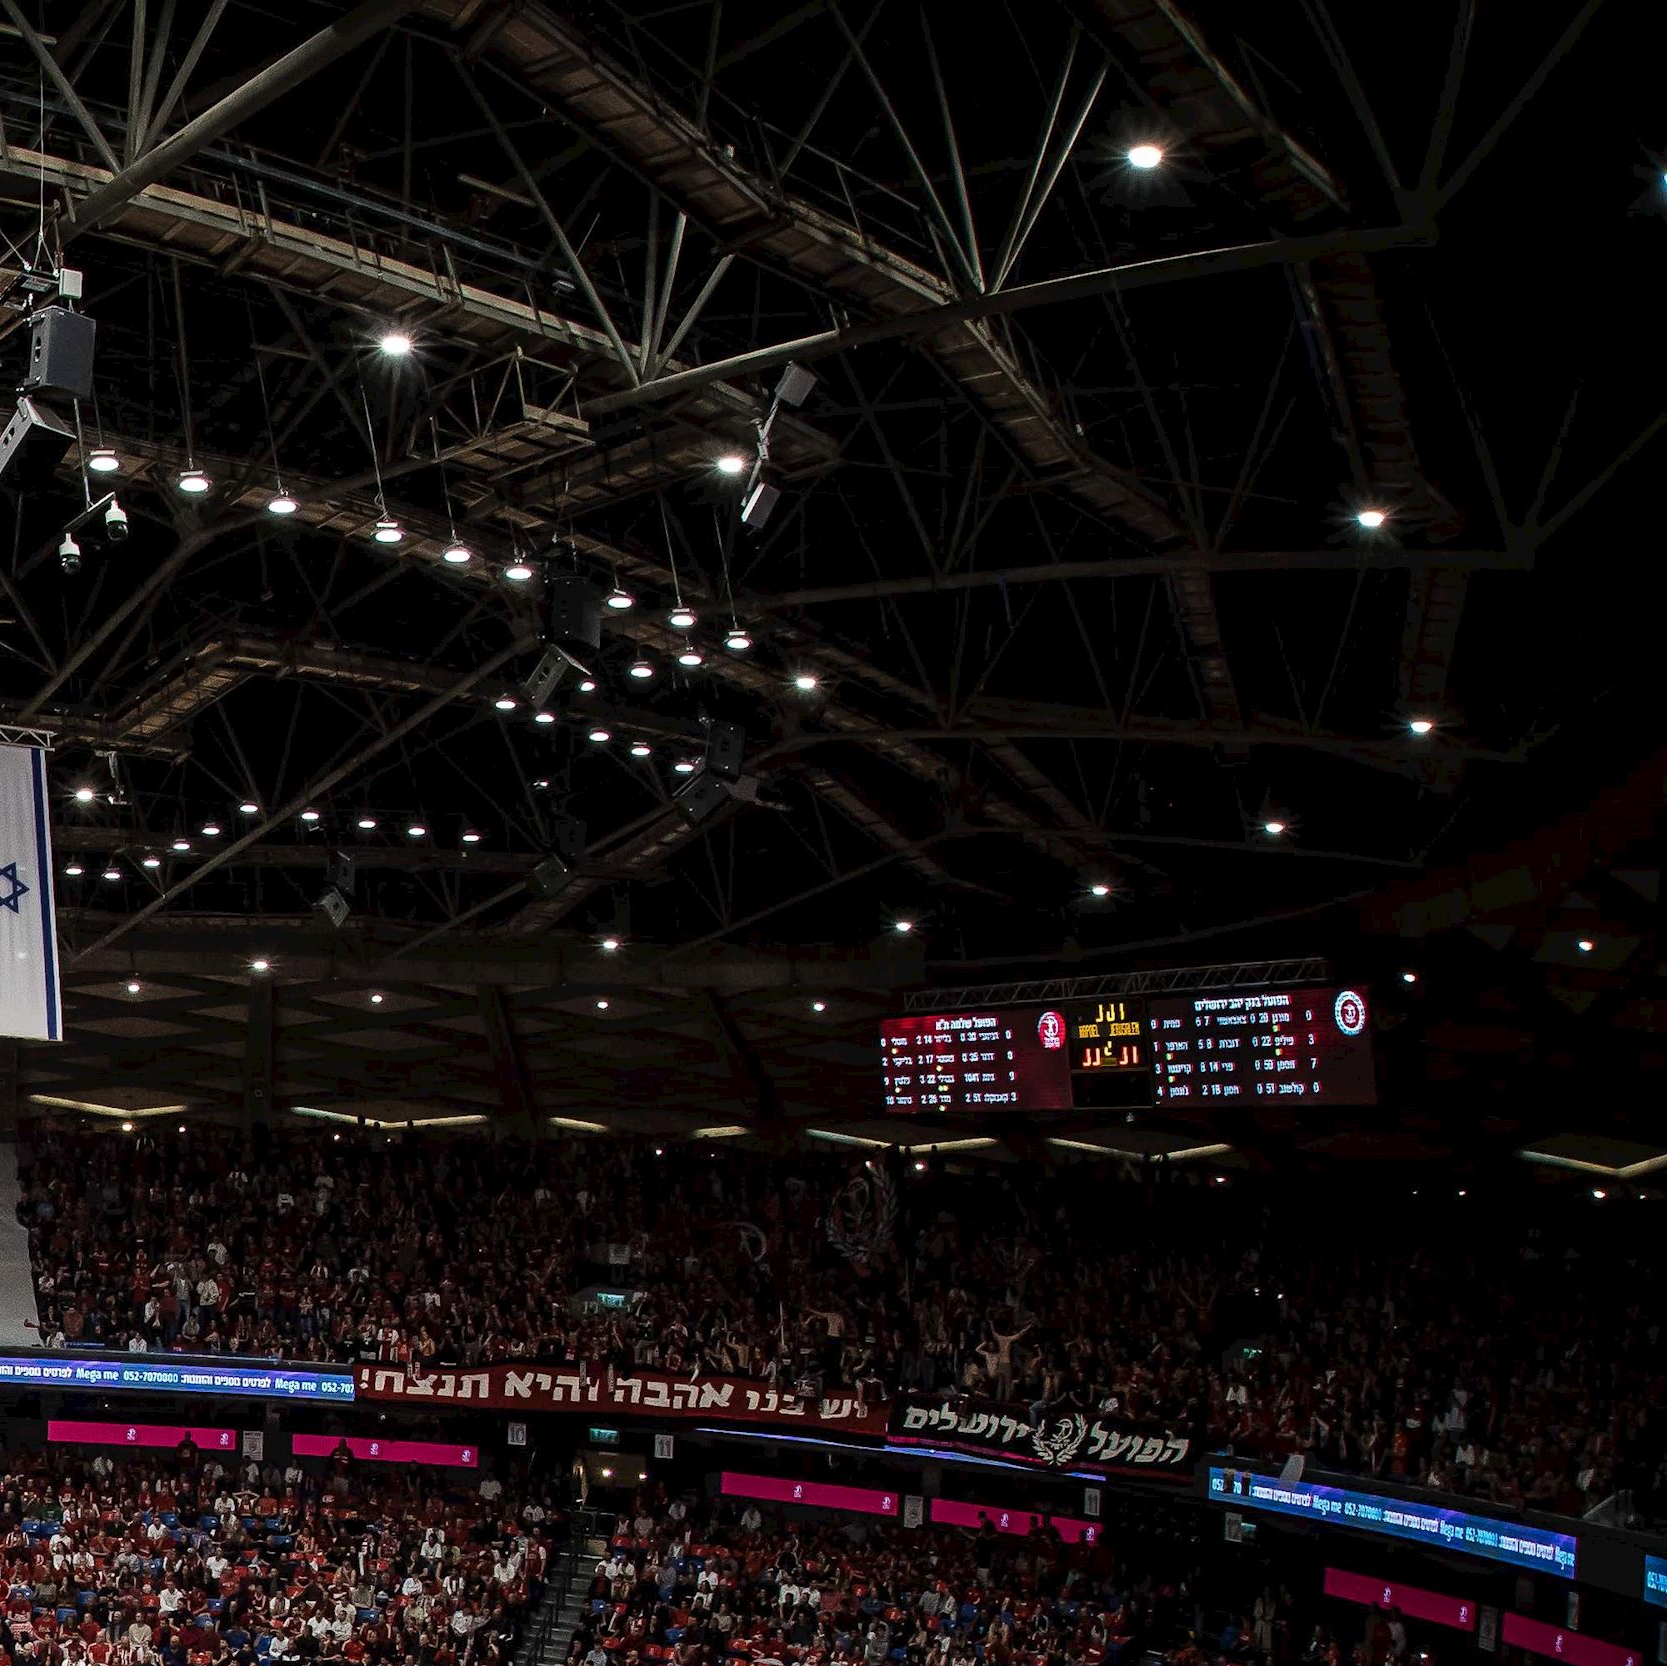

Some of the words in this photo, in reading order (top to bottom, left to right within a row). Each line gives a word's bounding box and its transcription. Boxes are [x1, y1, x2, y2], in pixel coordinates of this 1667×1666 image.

[76, 1368, 101, 1383] Mega
[104, 1371, 119, 1381] me
[123, 1371, 178, 1383] 052-7070000
[274, 1377, 300, 1392] Mega
[302, 1381, 317, 1391] me
[360, 1367, 489, 1399] תנצח!
[614, 1376, 735, 1410] אהבה
[905, 1402, 1030, 1444] ירושלים
[1088, 1423, 1190, 1466] הפועל
